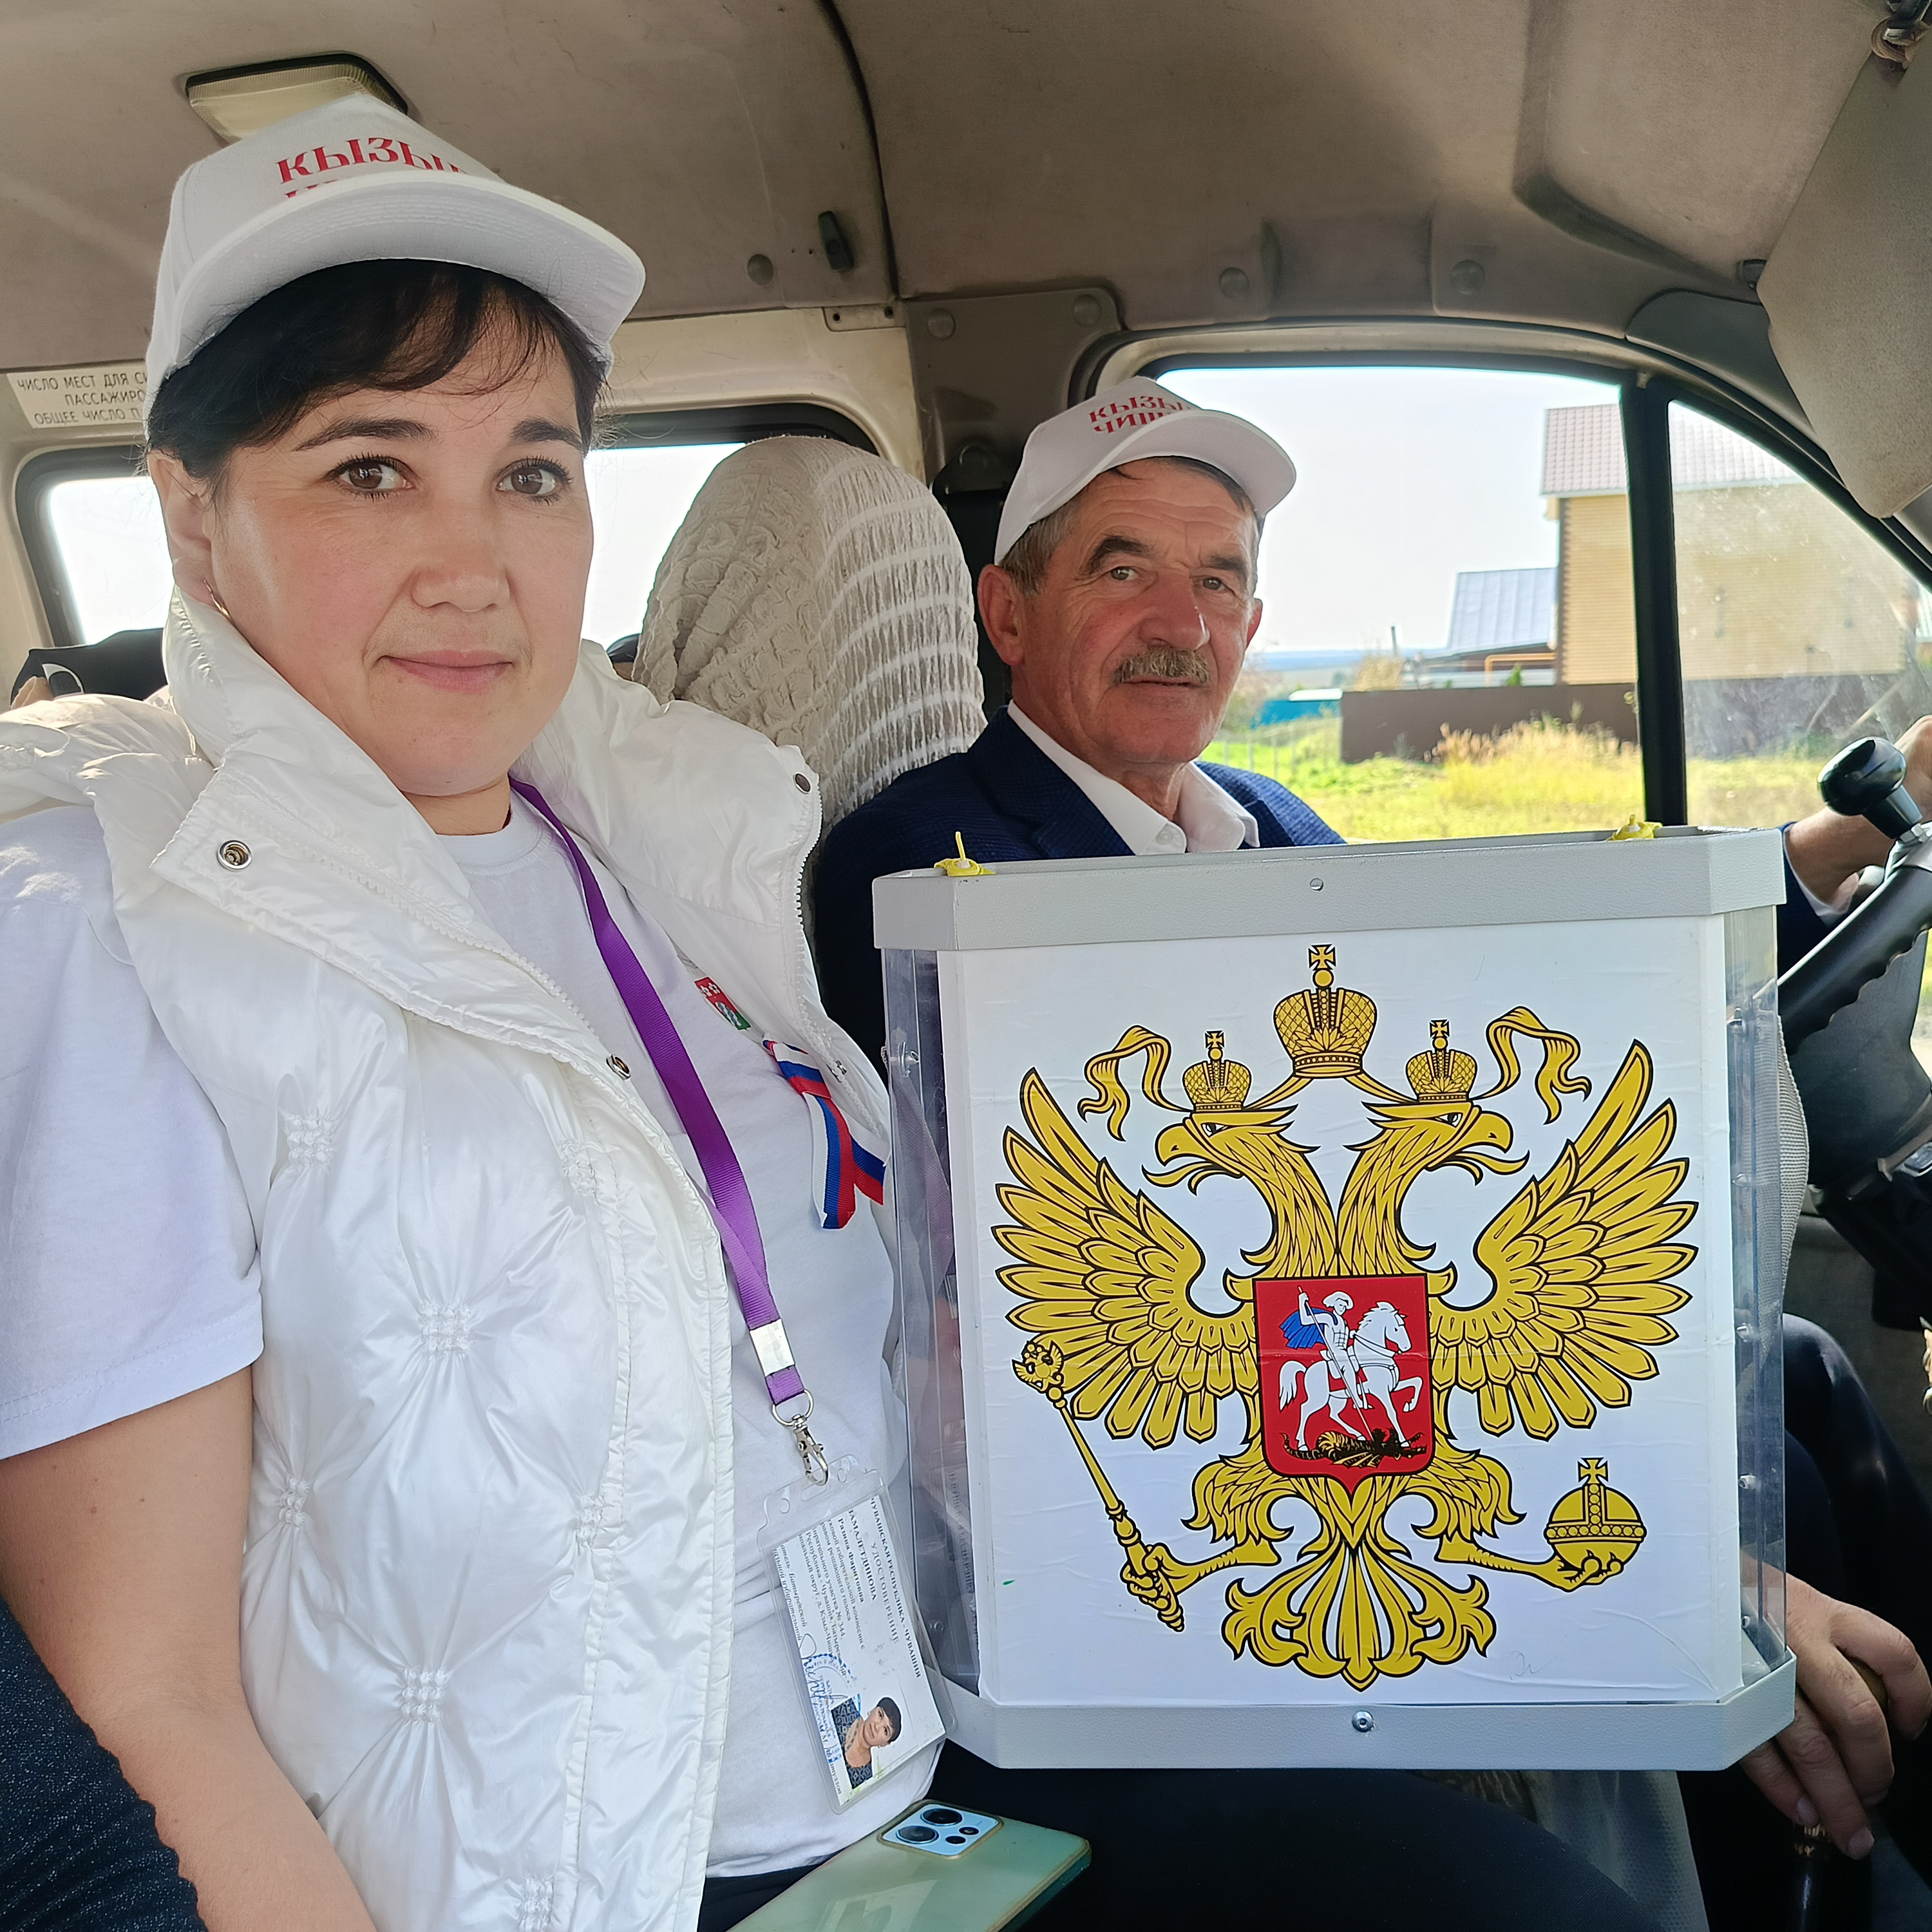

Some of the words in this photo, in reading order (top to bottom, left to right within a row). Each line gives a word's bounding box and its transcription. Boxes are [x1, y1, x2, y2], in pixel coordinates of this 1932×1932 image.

[17, 377, 59, 392] ЧИСЛО
[64, 375, 95, 389] МЕСТ
[104, 373, 129, 387] ДЛЯ
[34, 411, 79, 424] ОБЩЕЕ
[82, 408, 126, 422] ЧИСЛО
[804, 1531, 822, 1578] Республика
[837, 1518, 851, 1549] Разина
[846, 1551, 866, 1603] Фаритовна
[781, 1580, 804, 1640] избирательной
[788, 1572, 808, 1627] Батыревской
[824, 1579, 839, 1610] участка
[826, 1546, 845, 1593] решающего
[840, 1595, 851, 1621] голоса
[835, 1546, 857, 1604] избирательной
[851, 1605, 863, 1643] комиссии
[887, 1559, 906, 1623] РЕСПУБЛИКА
[903, 1628, 921, 1678] ЧУВАШИЯ
